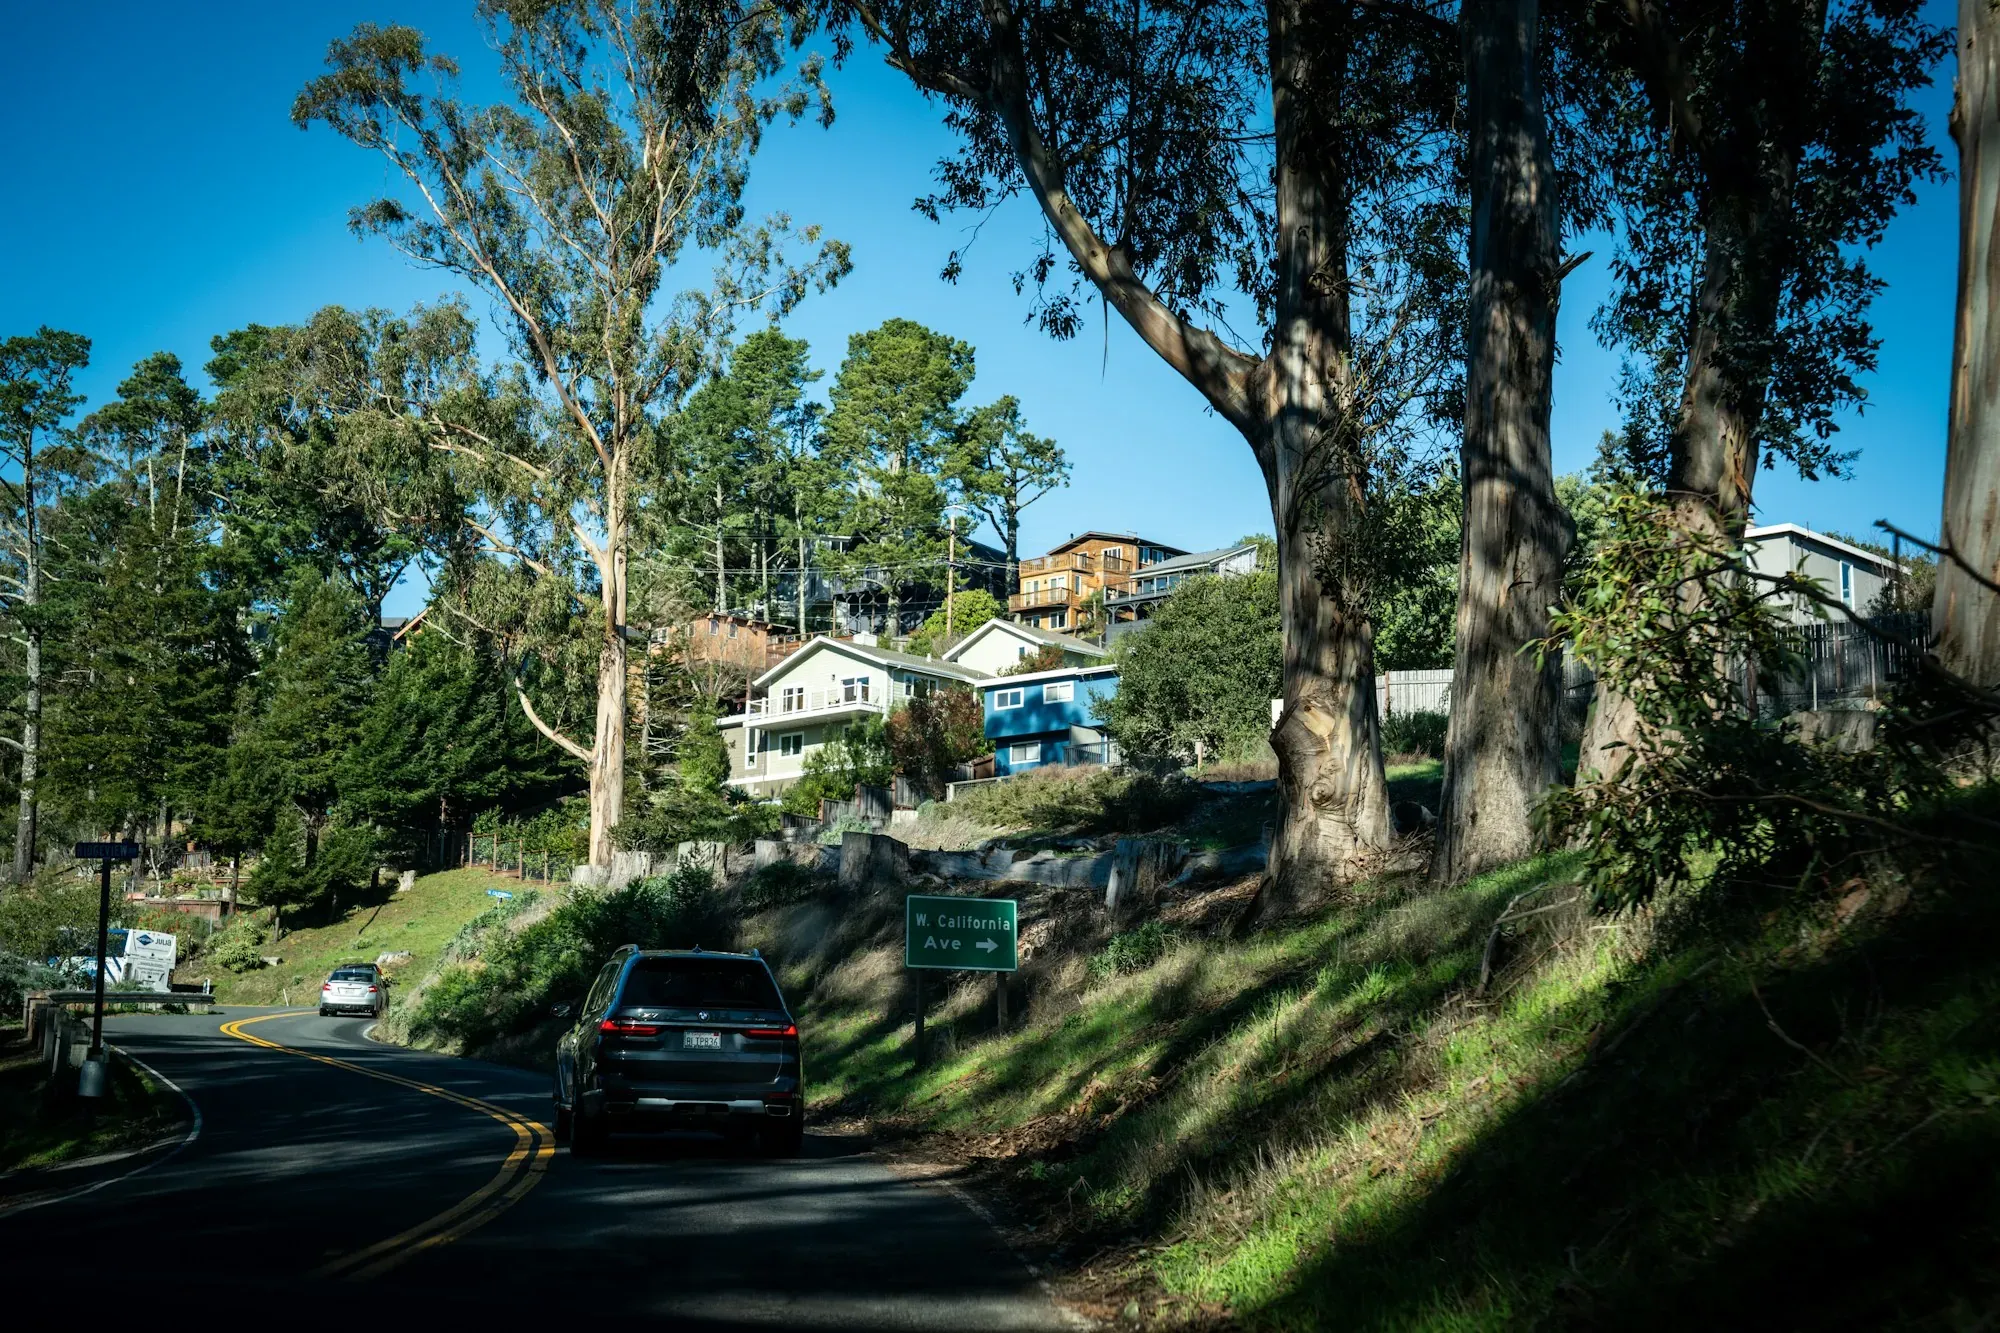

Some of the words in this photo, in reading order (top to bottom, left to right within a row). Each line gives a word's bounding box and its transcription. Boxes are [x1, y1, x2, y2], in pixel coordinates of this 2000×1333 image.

[916, 913, 930, 927] W.
[938, 914, 1011, 931] California
[924, 935, 962, 950] Ave
